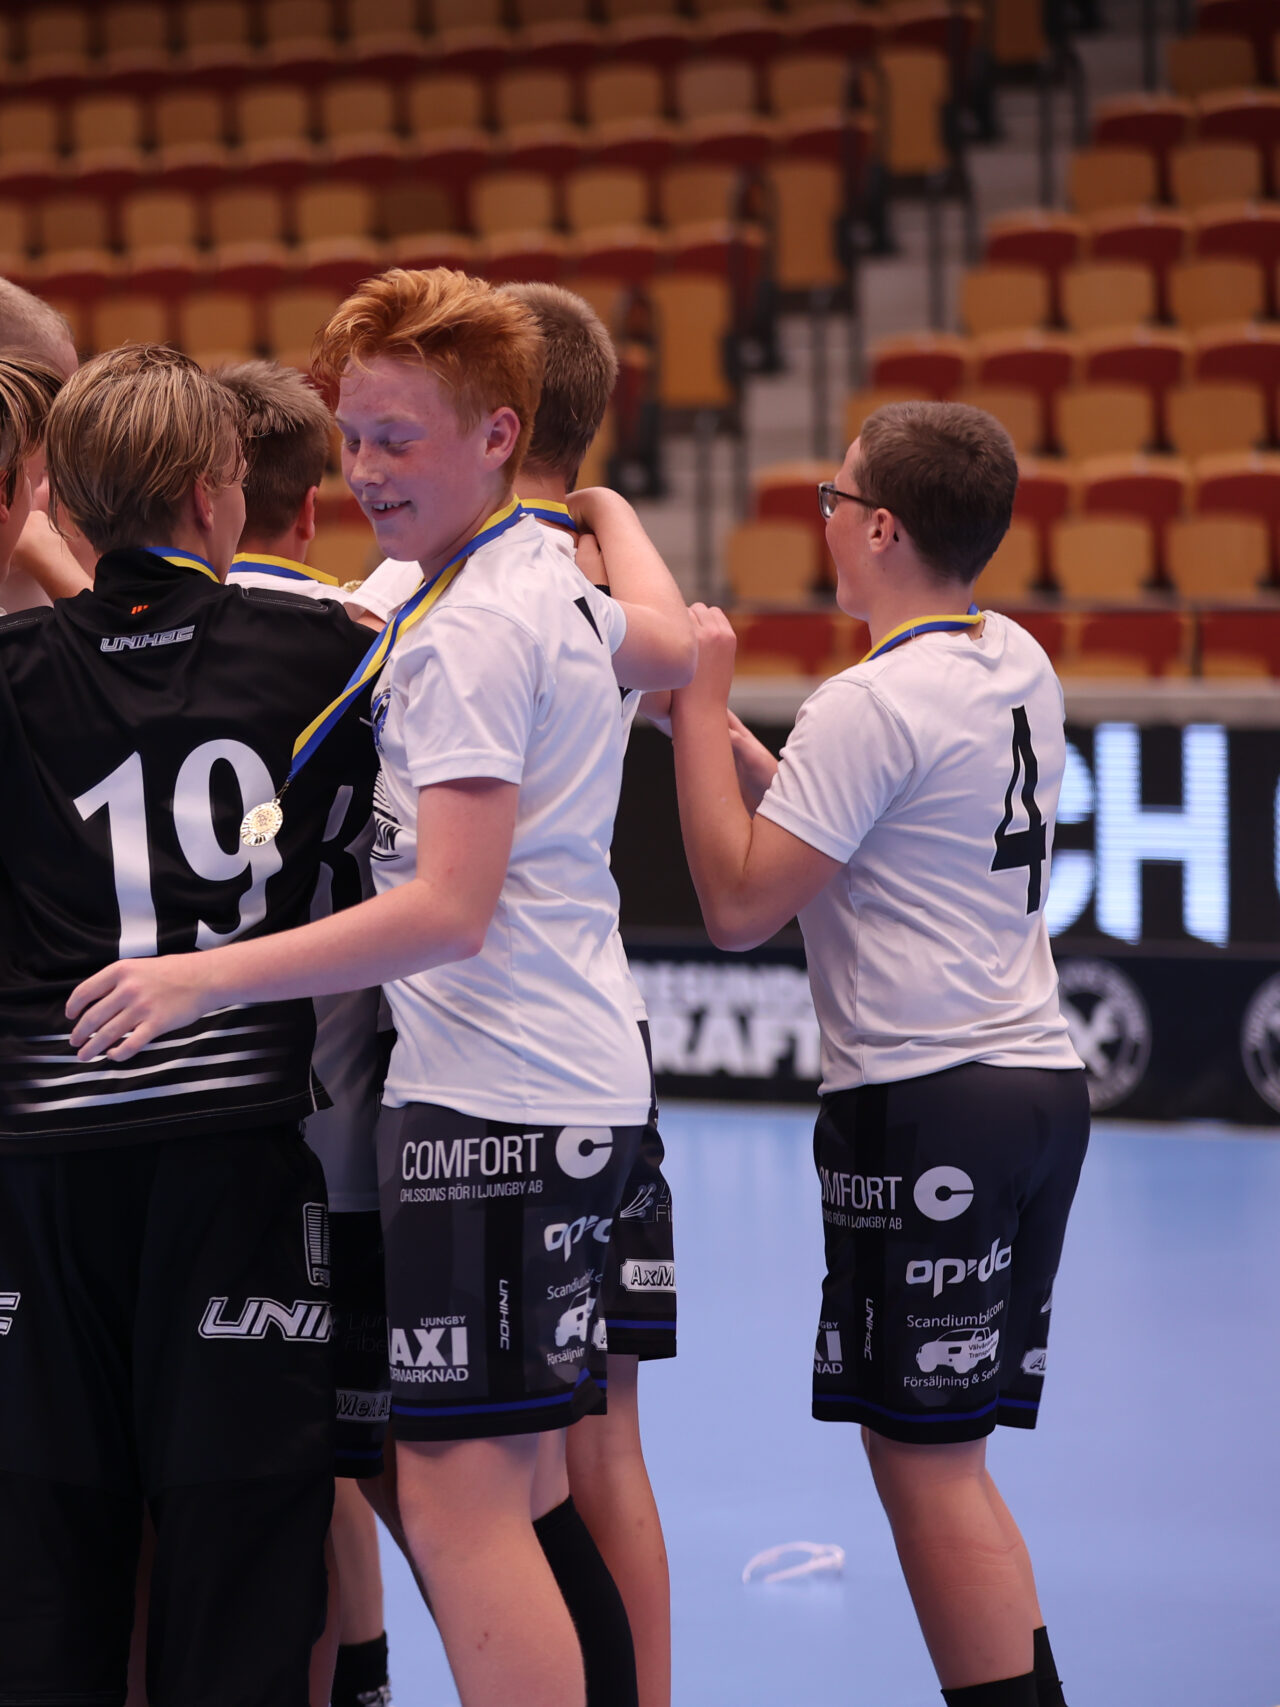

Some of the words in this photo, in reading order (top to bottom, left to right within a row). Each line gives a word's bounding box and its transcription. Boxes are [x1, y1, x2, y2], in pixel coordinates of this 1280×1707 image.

[990, 705, 1047, 917] 4
[72, 738, 283, 959] 19
[401, 1132, 545, 1181] COMFORT
[400, 1186, 447, 1203] OHLSSONS
[447, 1183, 471, 1201] RÖR
[477, 1181, 527, 1200] LJUNGBY
[528, 1179, 544, 1194] AB
[888, 1216, 903, 1231] AB
[420, 1315, 466, 1328] LJUNGBY
[498, 1278, 510, 1350] UNIHOC
[863, 1297, 874, 1361] UNIHOC
[387, 1326, 470, 1368] AXI
[903, 1374, 969, 1389] Försäljning
